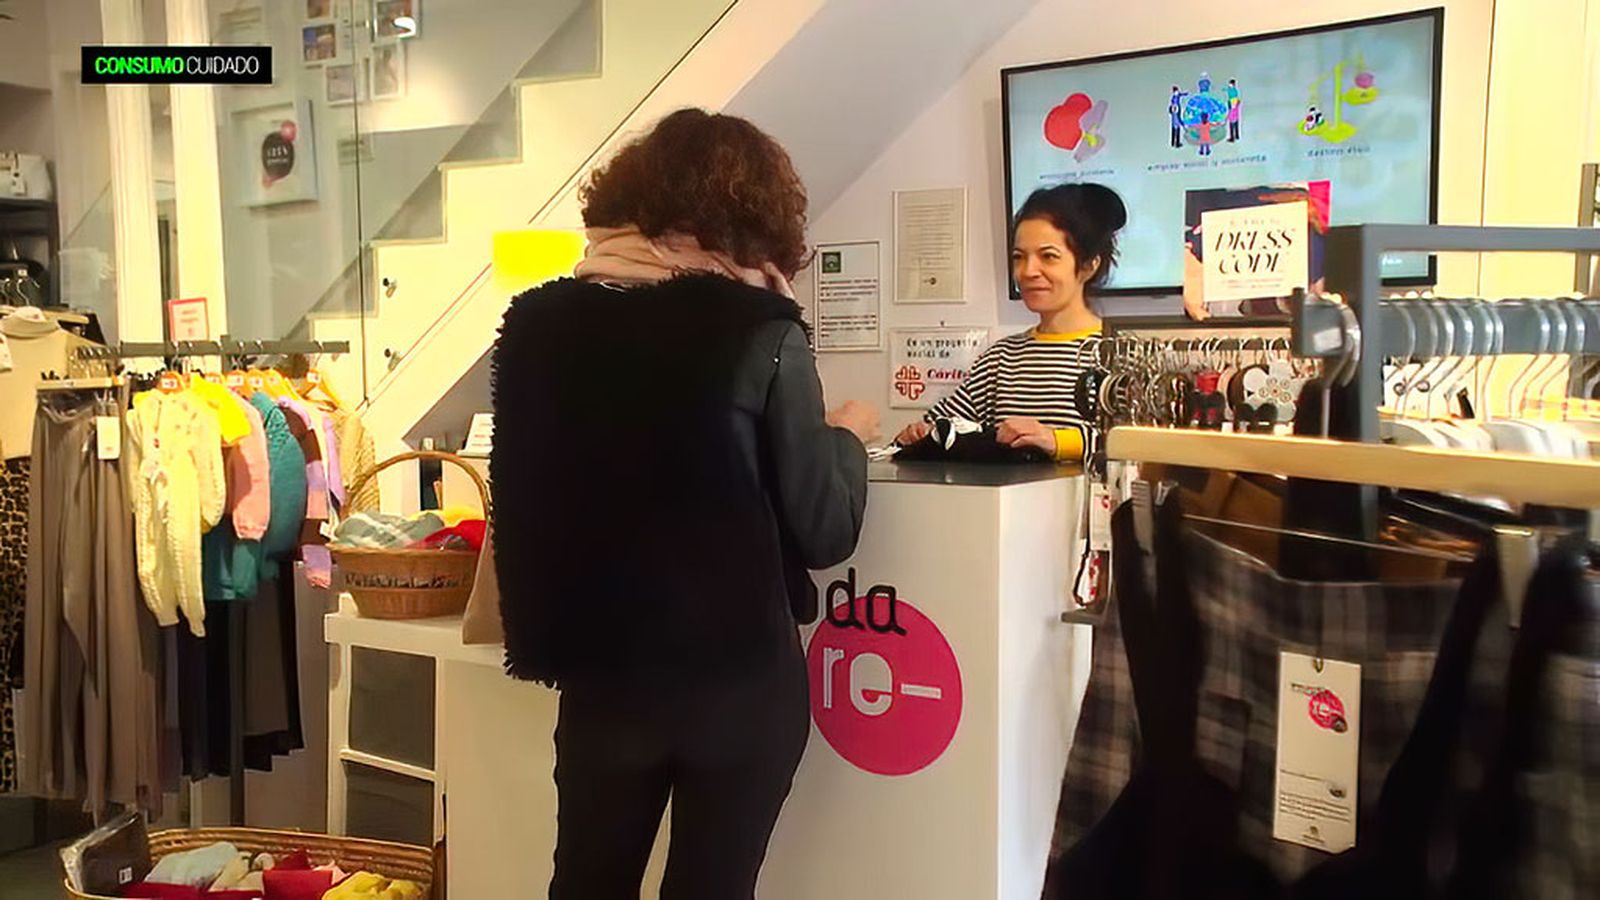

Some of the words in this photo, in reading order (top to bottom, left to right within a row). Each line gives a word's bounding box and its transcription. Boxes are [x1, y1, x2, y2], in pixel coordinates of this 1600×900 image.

[1214, 229, 1296, 252] DRESS
[1218, 252, 1291, 275] CODE
[939, 348, 951, 359] de
